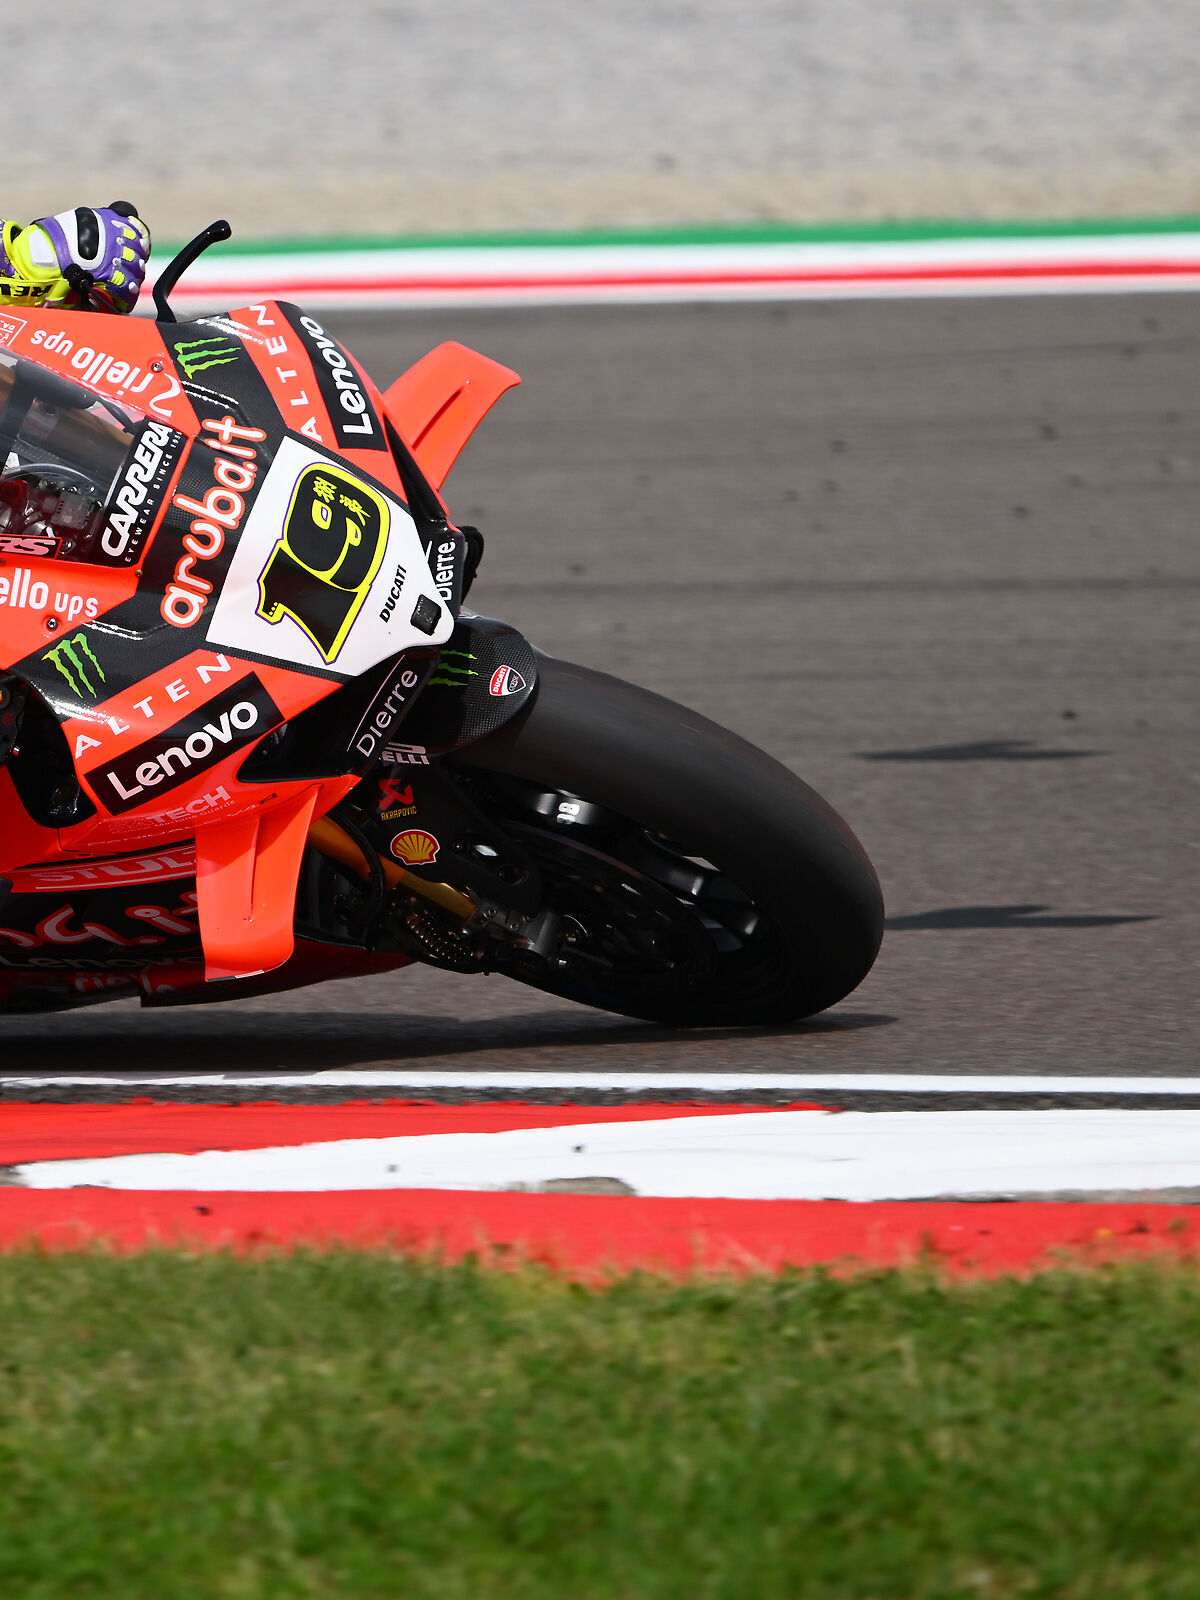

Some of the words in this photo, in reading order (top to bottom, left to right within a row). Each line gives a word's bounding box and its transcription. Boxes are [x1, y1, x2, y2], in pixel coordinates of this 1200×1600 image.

[30, 329, 74, 358] ups
[74, 353, 155, 397] riello
[249, 304, 324, 443] ALTEN
[299, 315, 375, 437] Lenovo
[100, 421, 174, 558] CARRERA
[124, 498, 155, 563] EYEWEAR
[153, 453, 173, 490] SINCE
[164, 417, 266, 626] aruba.it
[53, 593, 100, 621] ups
[379, 564, 408, 624] DUCATI
[74, 653, 233, 760] ALTEN
[492, 667, 507, 693] DUCATI
[106, 701, 260, 801] Lenovo
[29, 848, 197, 883] STUL
